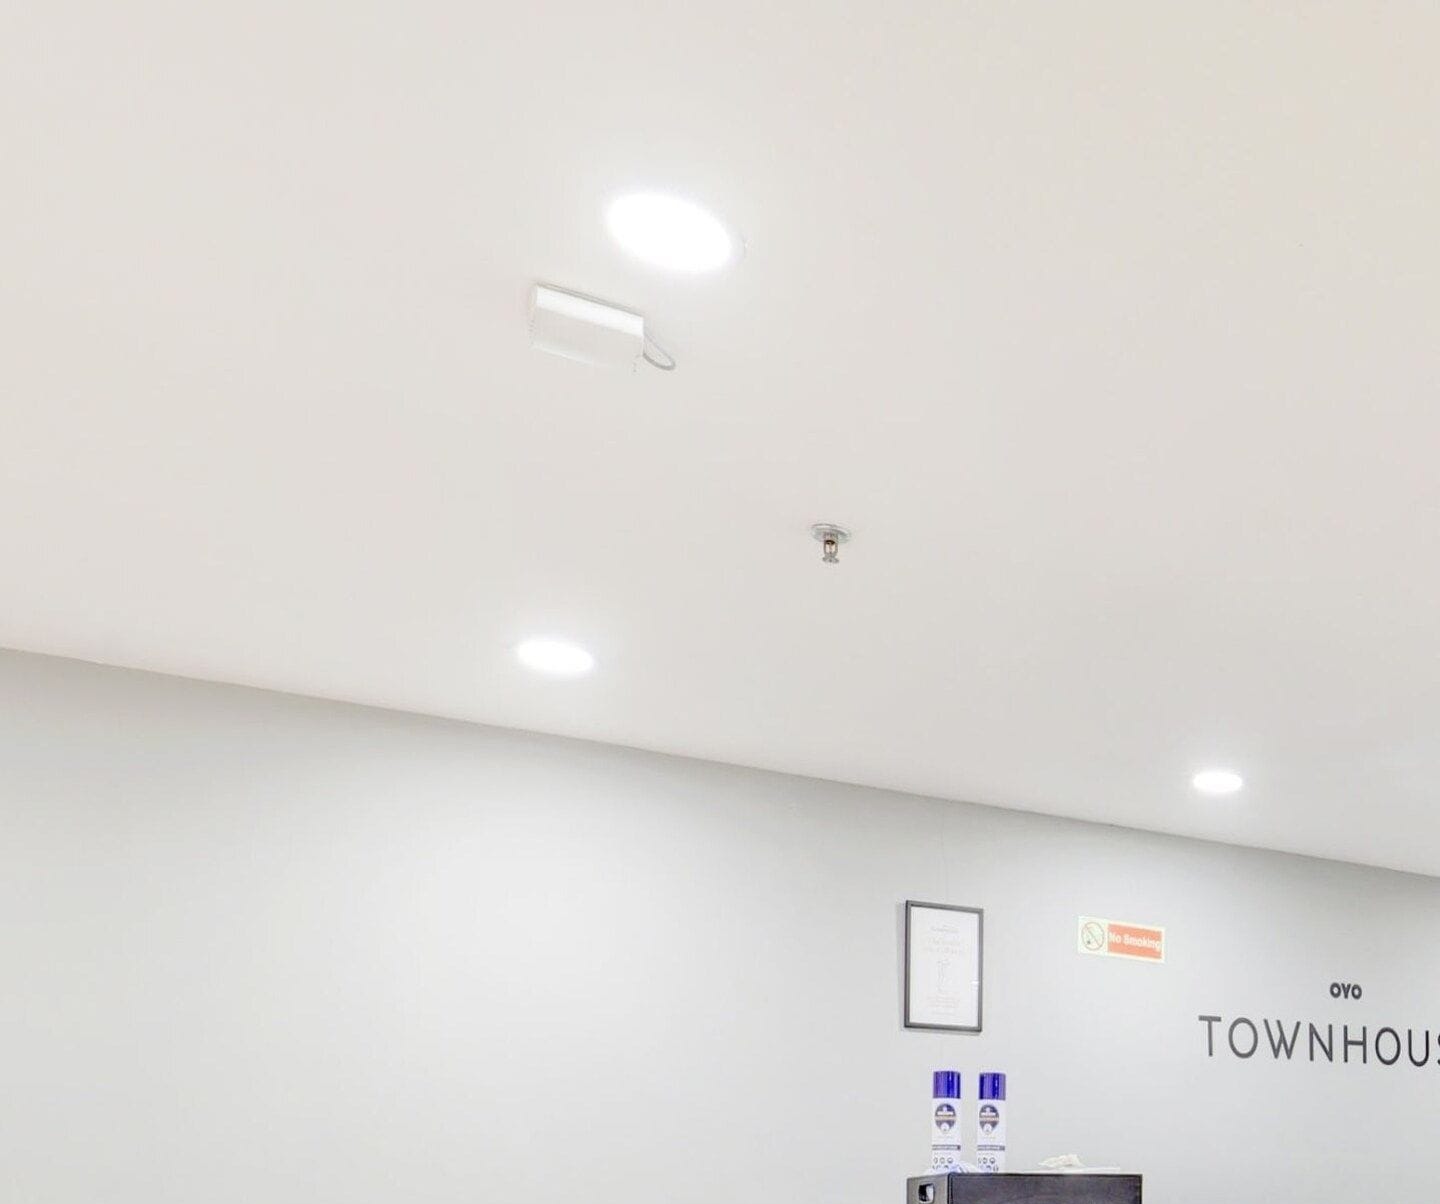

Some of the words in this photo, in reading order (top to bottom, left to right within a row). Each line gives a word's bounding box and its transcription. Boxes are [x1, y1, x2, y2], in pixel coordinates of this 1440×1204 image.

[1107, 932, 1121, 944] No
[1123, 933, 1161, 952] Smoking
[1329, 982, 1362, 1000] OYO
